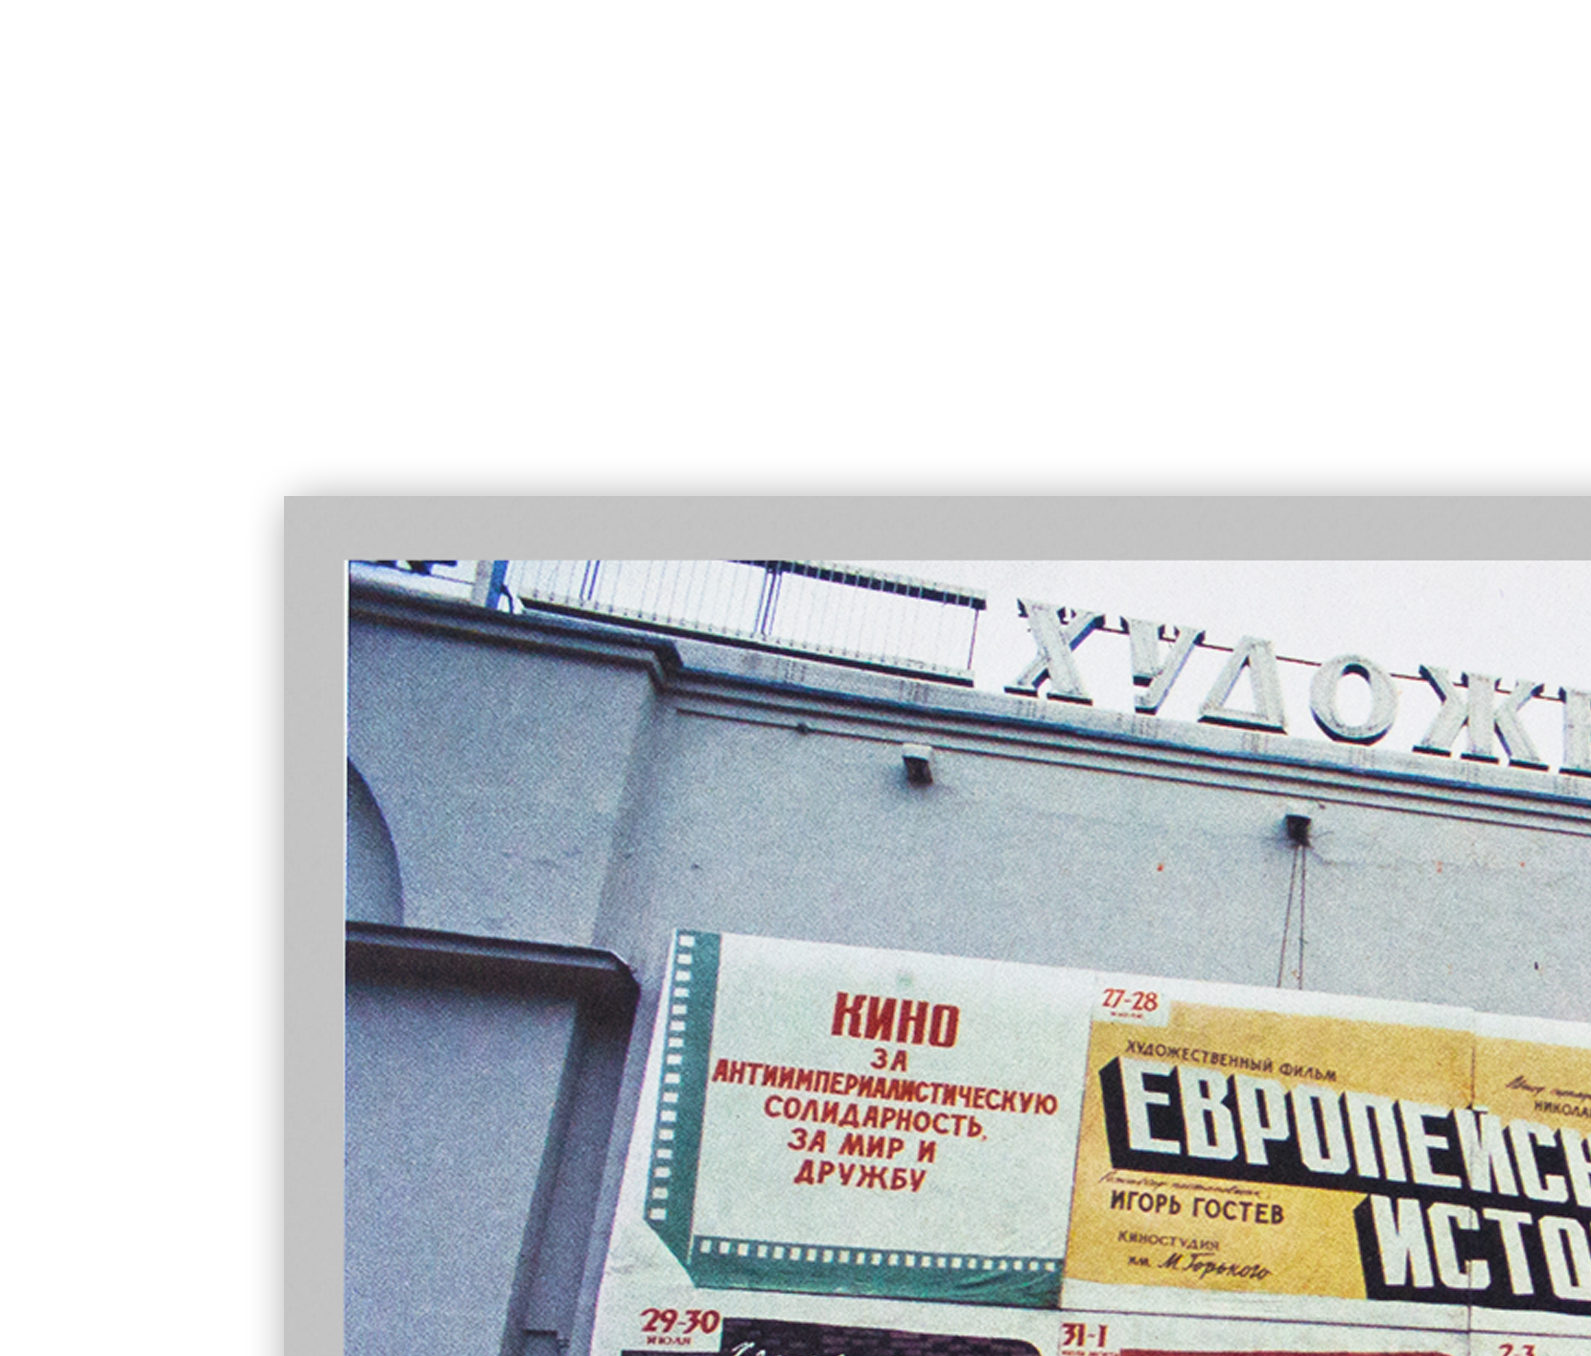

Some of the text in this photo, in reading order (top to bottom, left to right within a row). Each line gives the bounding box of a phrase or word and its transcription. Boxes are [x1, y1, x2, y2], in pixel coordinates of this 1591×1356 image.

[1102, 987, 1158, 1012] 27-28
[831, 991, 959, 1048] КИНО
[870, 1048, 908, 1071] ЗА
[1126, 1040, 1337, 1082] ХУДОЖЕСТВЕННЫЙ ФИЛЬМ
[712, 1059, 1058, 1115] АНТИИМПЕРИАЛИСТИЧЕСКУЮ
[787, 1128, 936, 1163] ЗА МИР И
[794, 1160, 926, 1192] ДРУЖБУ
[1110, 1189, 1285, 1224] ИГОРЬ ГОСТЕВ
[1118, 1230, 1220, 1251] КИНОСТУДИЯ
[639, 1307, 721, 1334] 29-30
